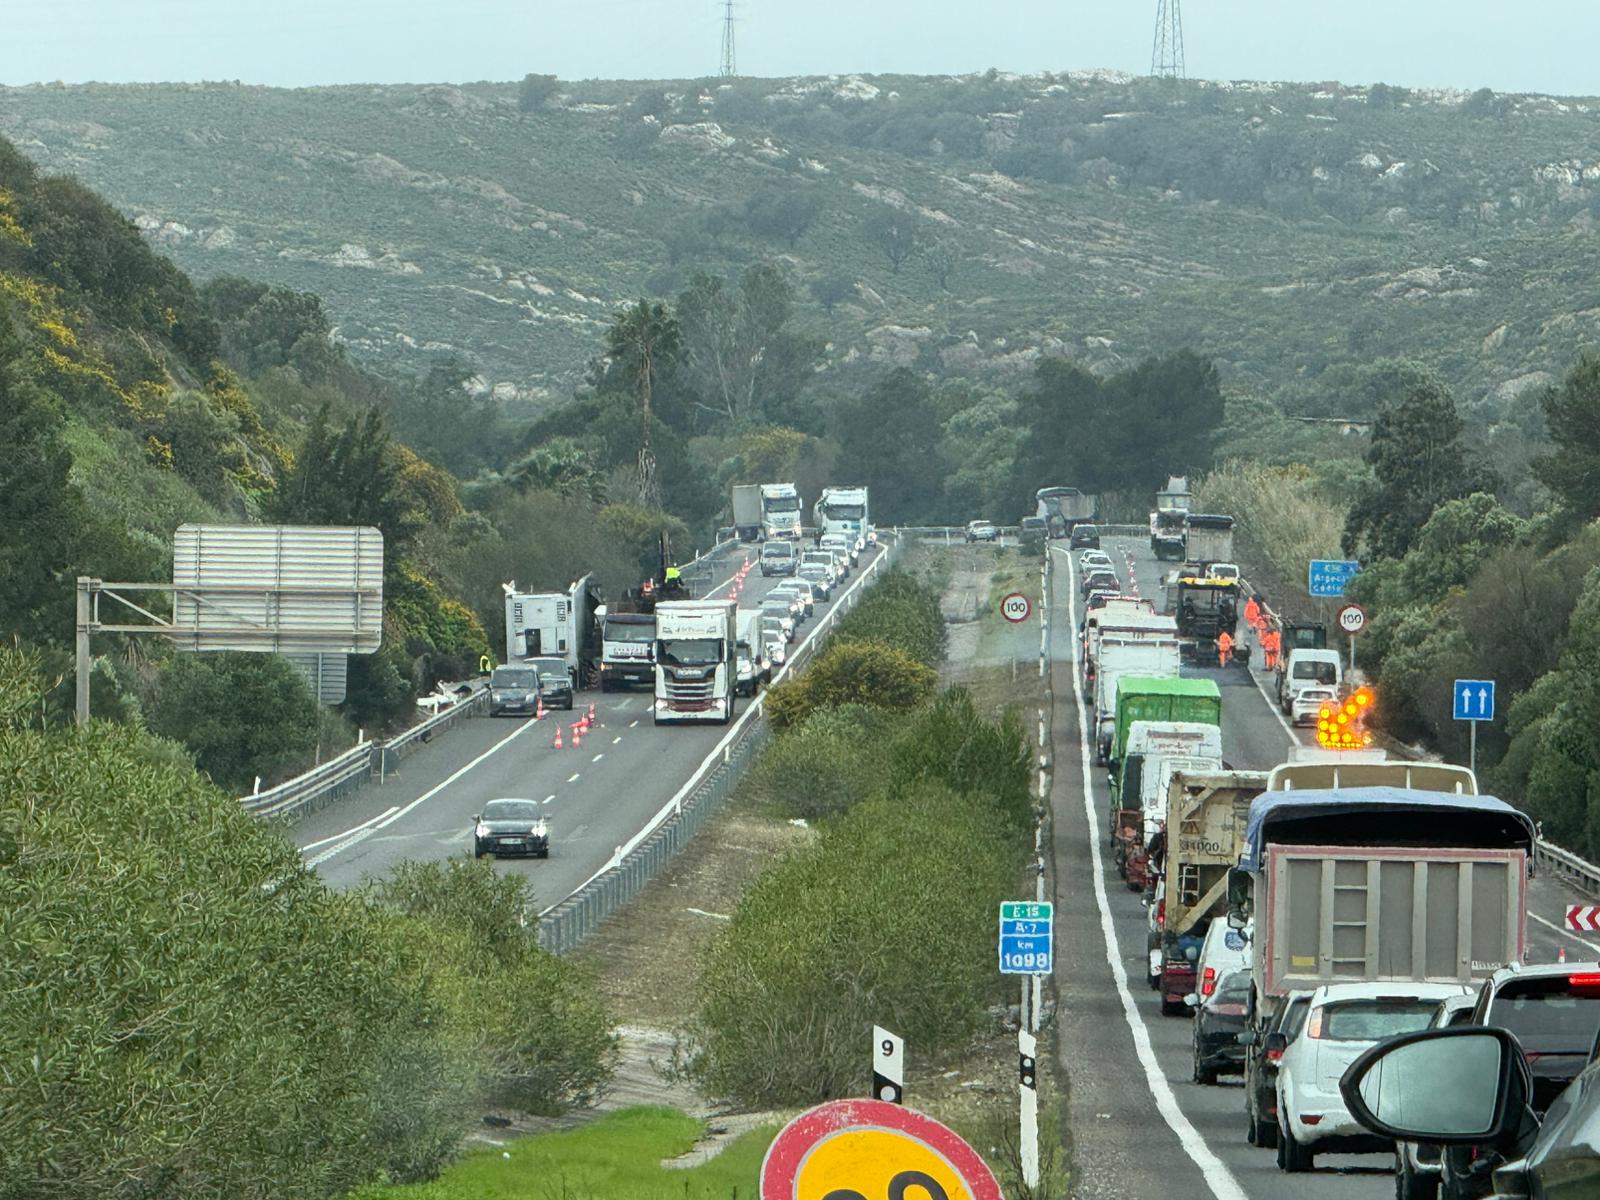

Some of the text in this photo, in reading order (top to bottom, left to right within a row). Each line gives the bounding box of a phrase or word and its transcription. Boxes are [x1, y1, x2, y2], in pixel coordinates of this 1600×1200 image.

[1007, 602, 1026, 612] 100
[1343, 614, 1362, 624] 100
[1017, 940, 1034, 949] km
[1004, 952, 1048, 968] 1098
[881, 1039, 894, 1057] 9
